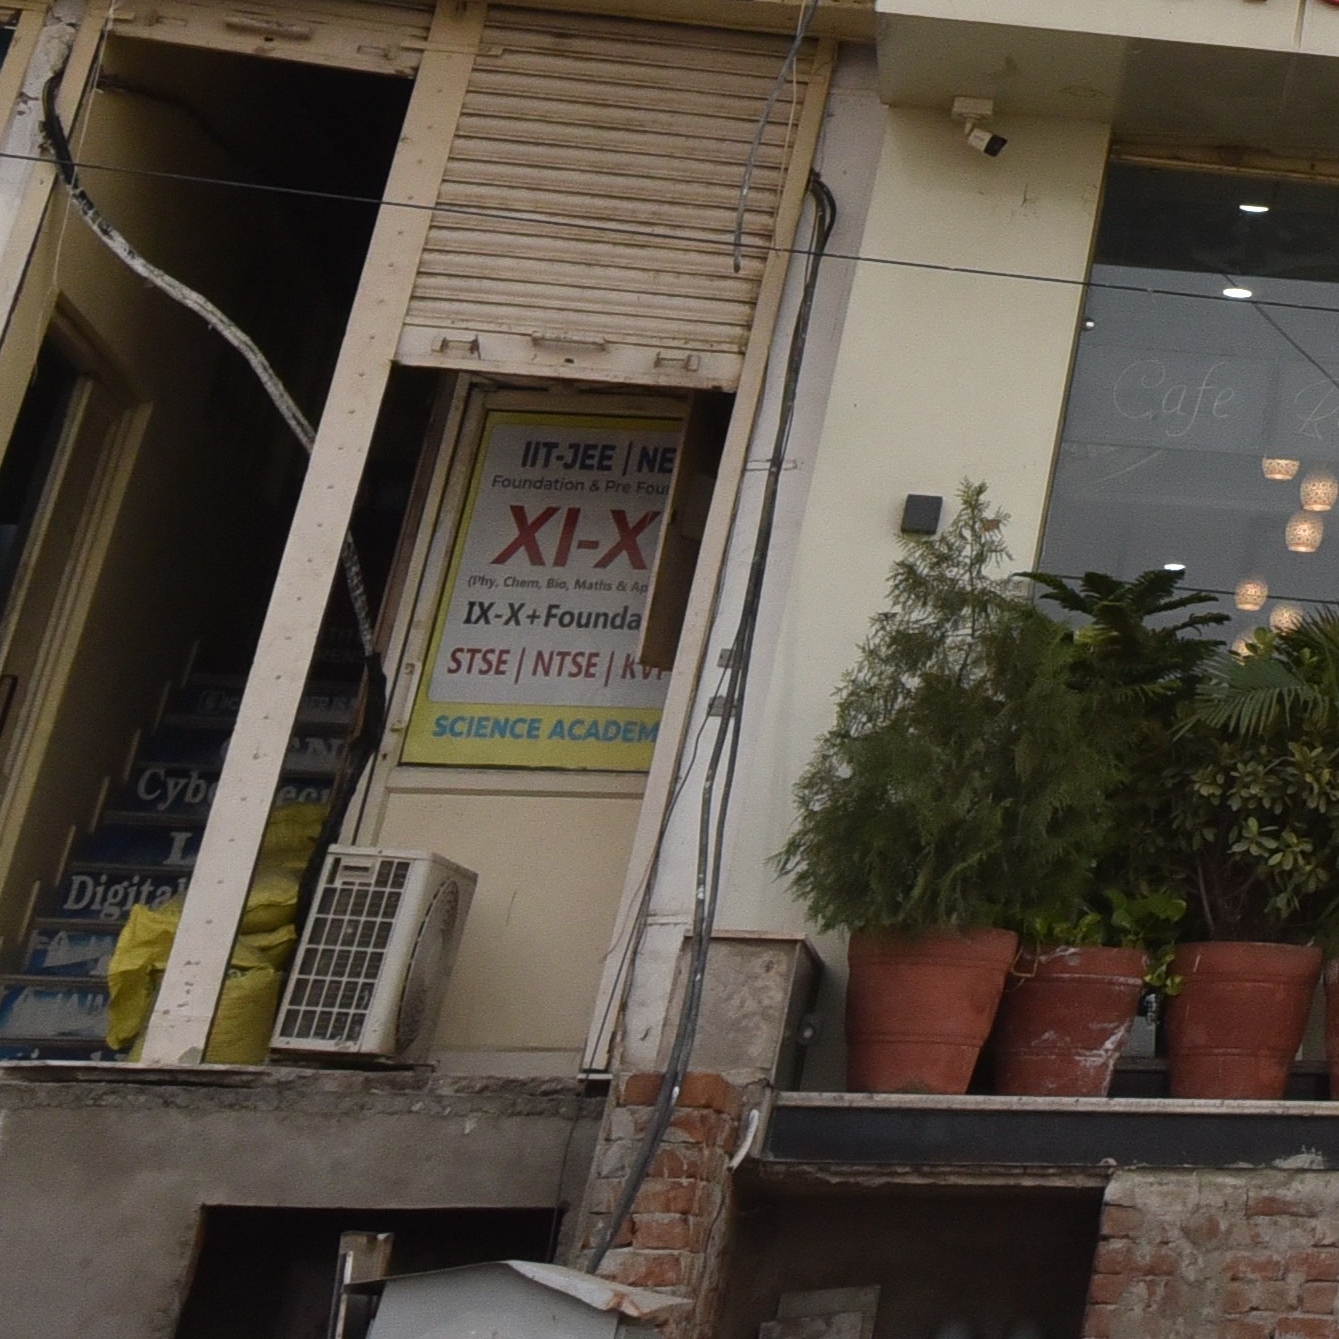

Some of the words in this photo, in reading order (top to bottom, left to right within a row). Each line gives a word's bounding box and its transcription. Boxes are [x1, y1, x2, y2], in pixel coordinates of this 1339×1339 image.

[1112, 359, 1237, 437] Cafe
[521, 440, 616, 472] IIT-JEE
[491, 475, 584, 492] Foundation
[605, 480, 630, 494] Pre
[490, 504, 662, 570] XI-X
[504, 576, 541, 590] Chem,
[546, 578, 570, 591] Bio,
[574, 578, 612, 592] Maths
[446, 647, 511, 676] STSE
[531, 650, 599, 679] NTSE
[432, 714, 541, 740] SCIENCE
[547, 717, 659, 743] ACADEM
